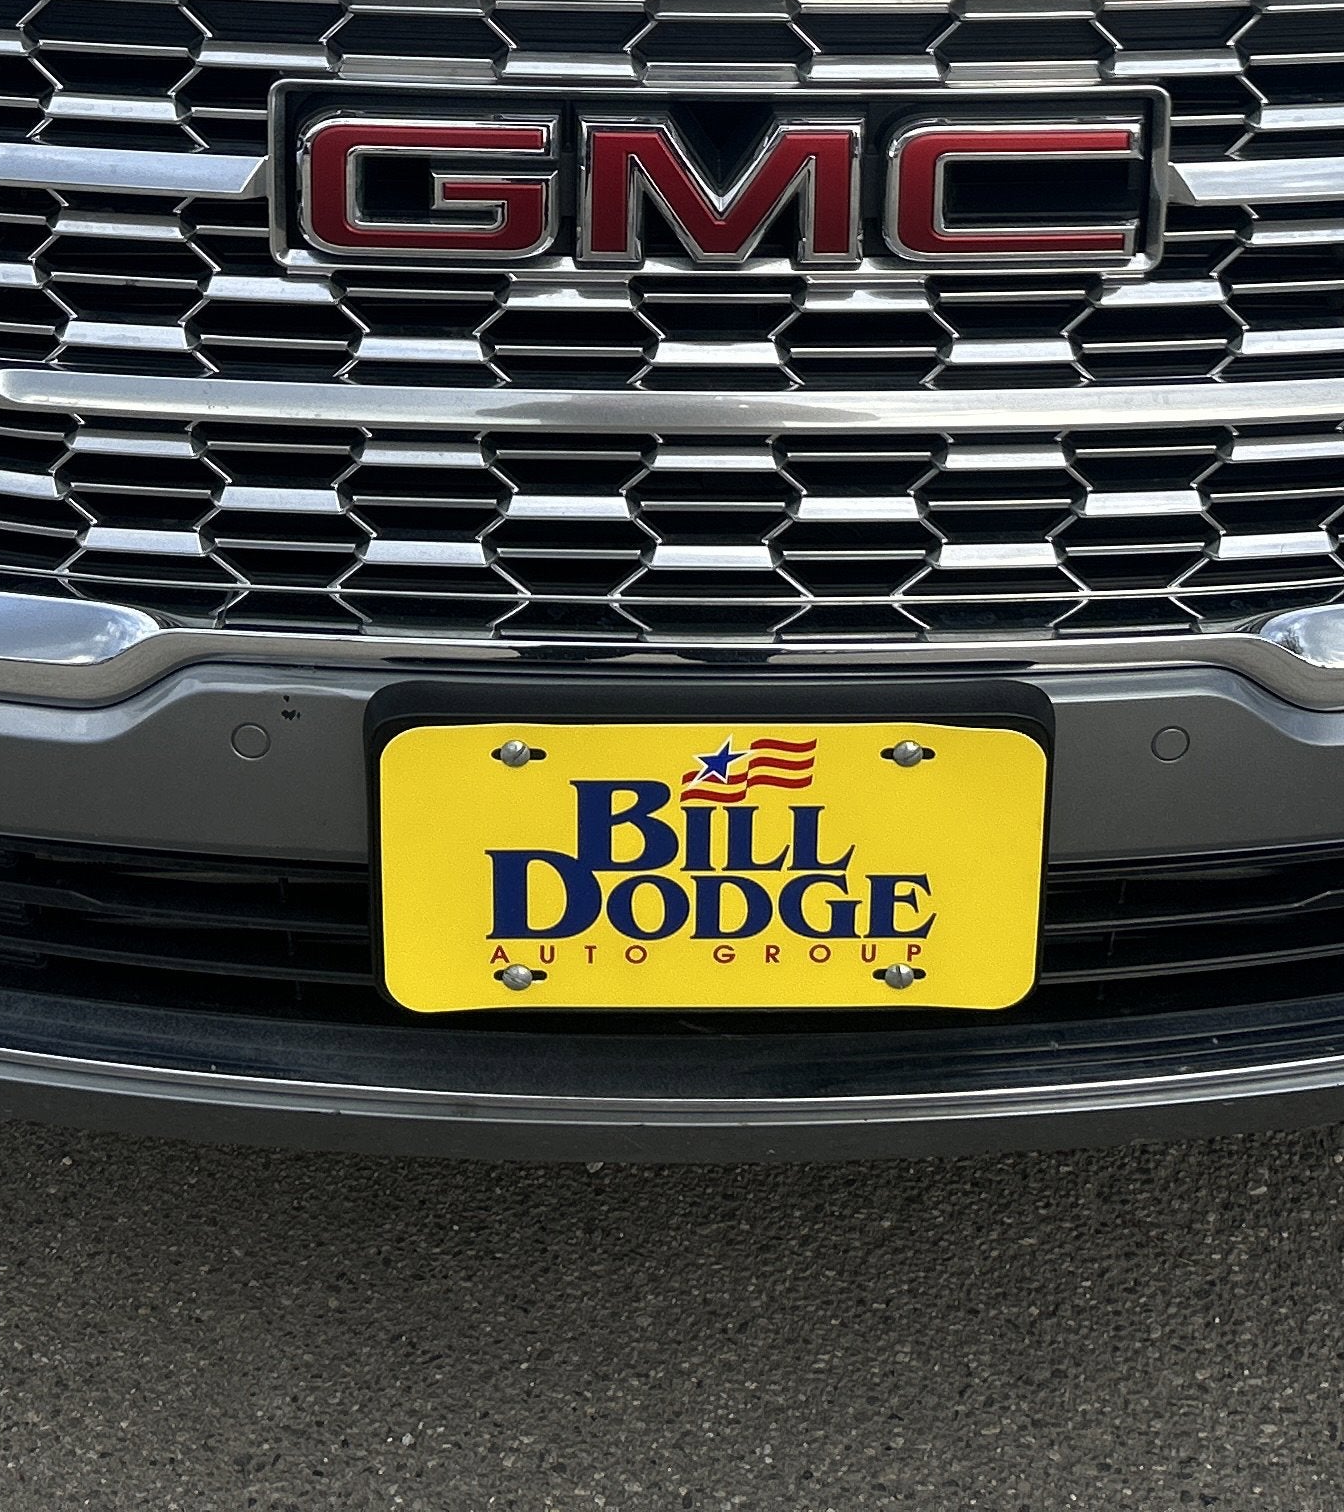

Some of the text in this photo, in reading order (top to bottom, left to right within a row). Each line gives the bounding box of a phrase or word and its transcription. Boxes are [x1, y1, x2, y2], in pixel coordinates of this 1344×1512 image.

[297, 108, 1144, 265] GMC
[569, 779, 856, 872] BILL
[484, 848, 937, 941] DODGE
[489, 943, 922, 965] AUTO GROUP
